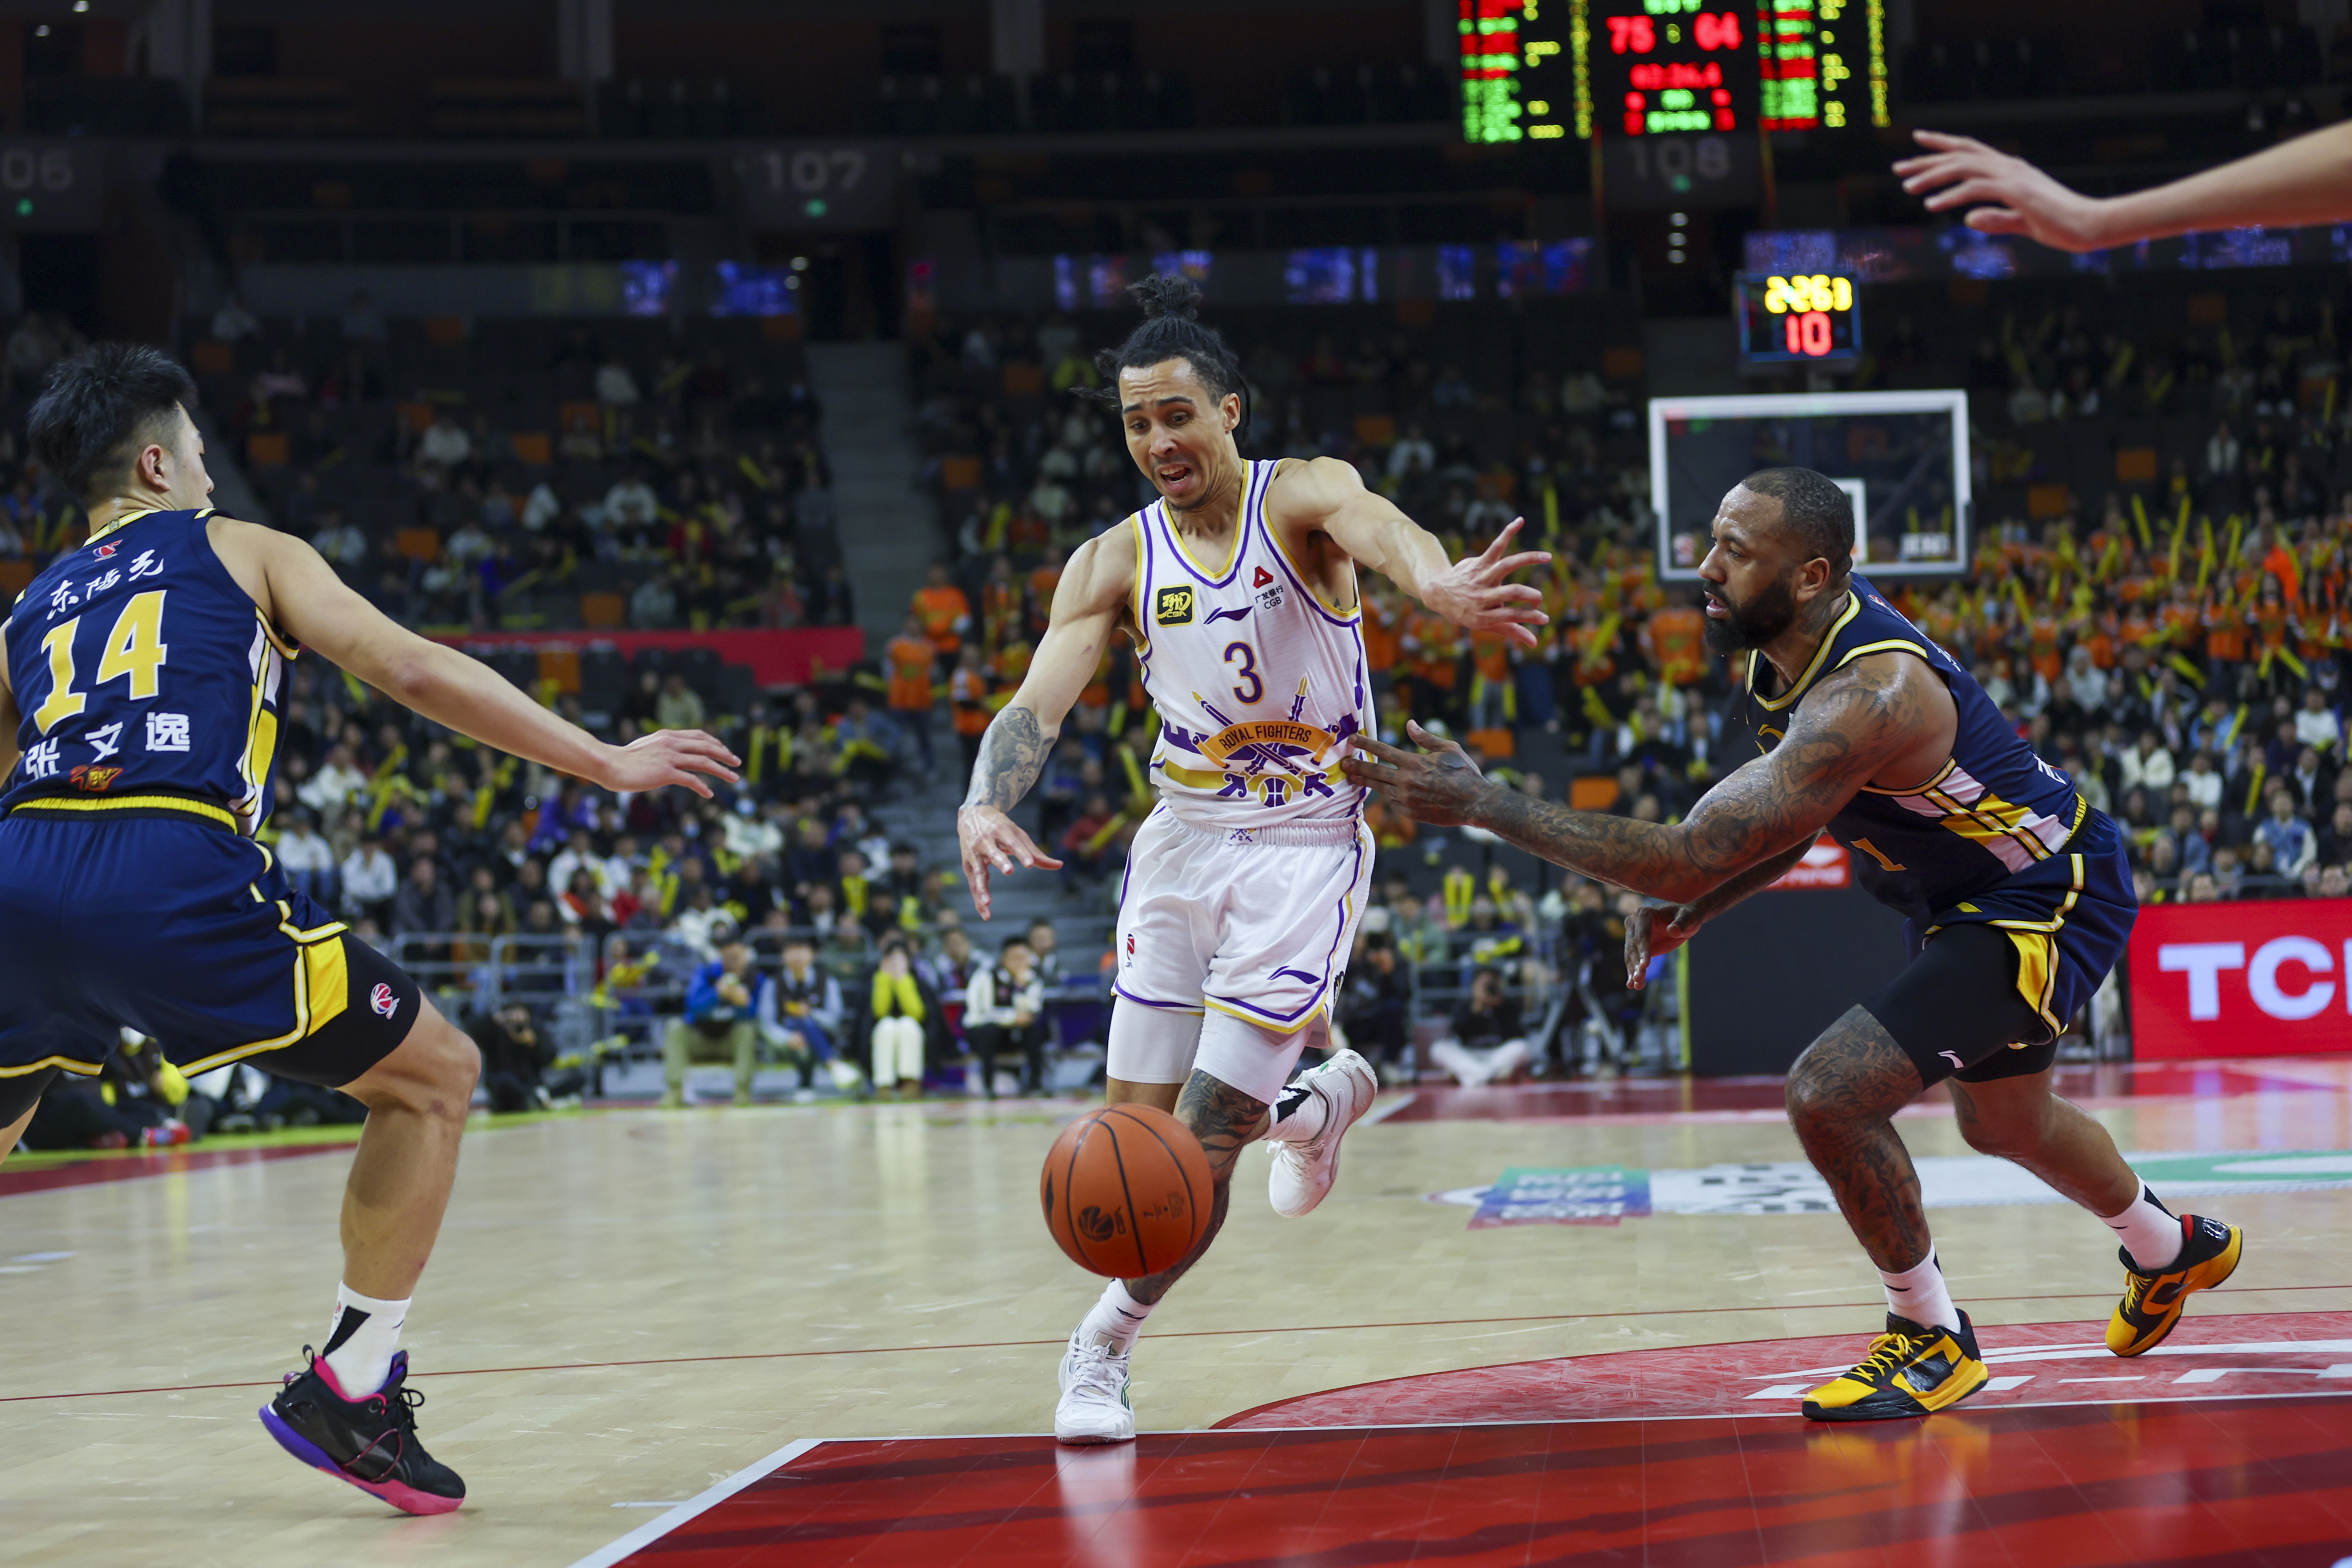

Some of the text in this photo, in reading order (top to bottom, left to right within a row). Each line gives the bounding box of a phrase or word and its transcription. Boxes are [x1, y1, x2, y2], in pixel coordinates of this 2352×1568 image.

[761, 149, 867, 192] 107
[1628, 136, 1732, 180] 108
[1785, 311, 1832, 356] 10
[1255, 585, 1284, 604] 广发银行
[1264, 596, 1282, 609] CGB
[33, 590, 168, 736] 14
[1224, 641, 1264, 706] 3
[25, 712, 191, 780] 张文逸
[1219, 725, 1312, 750] ROYAL FIGHTERS
[2157, 935, 2352, 1022] TC
